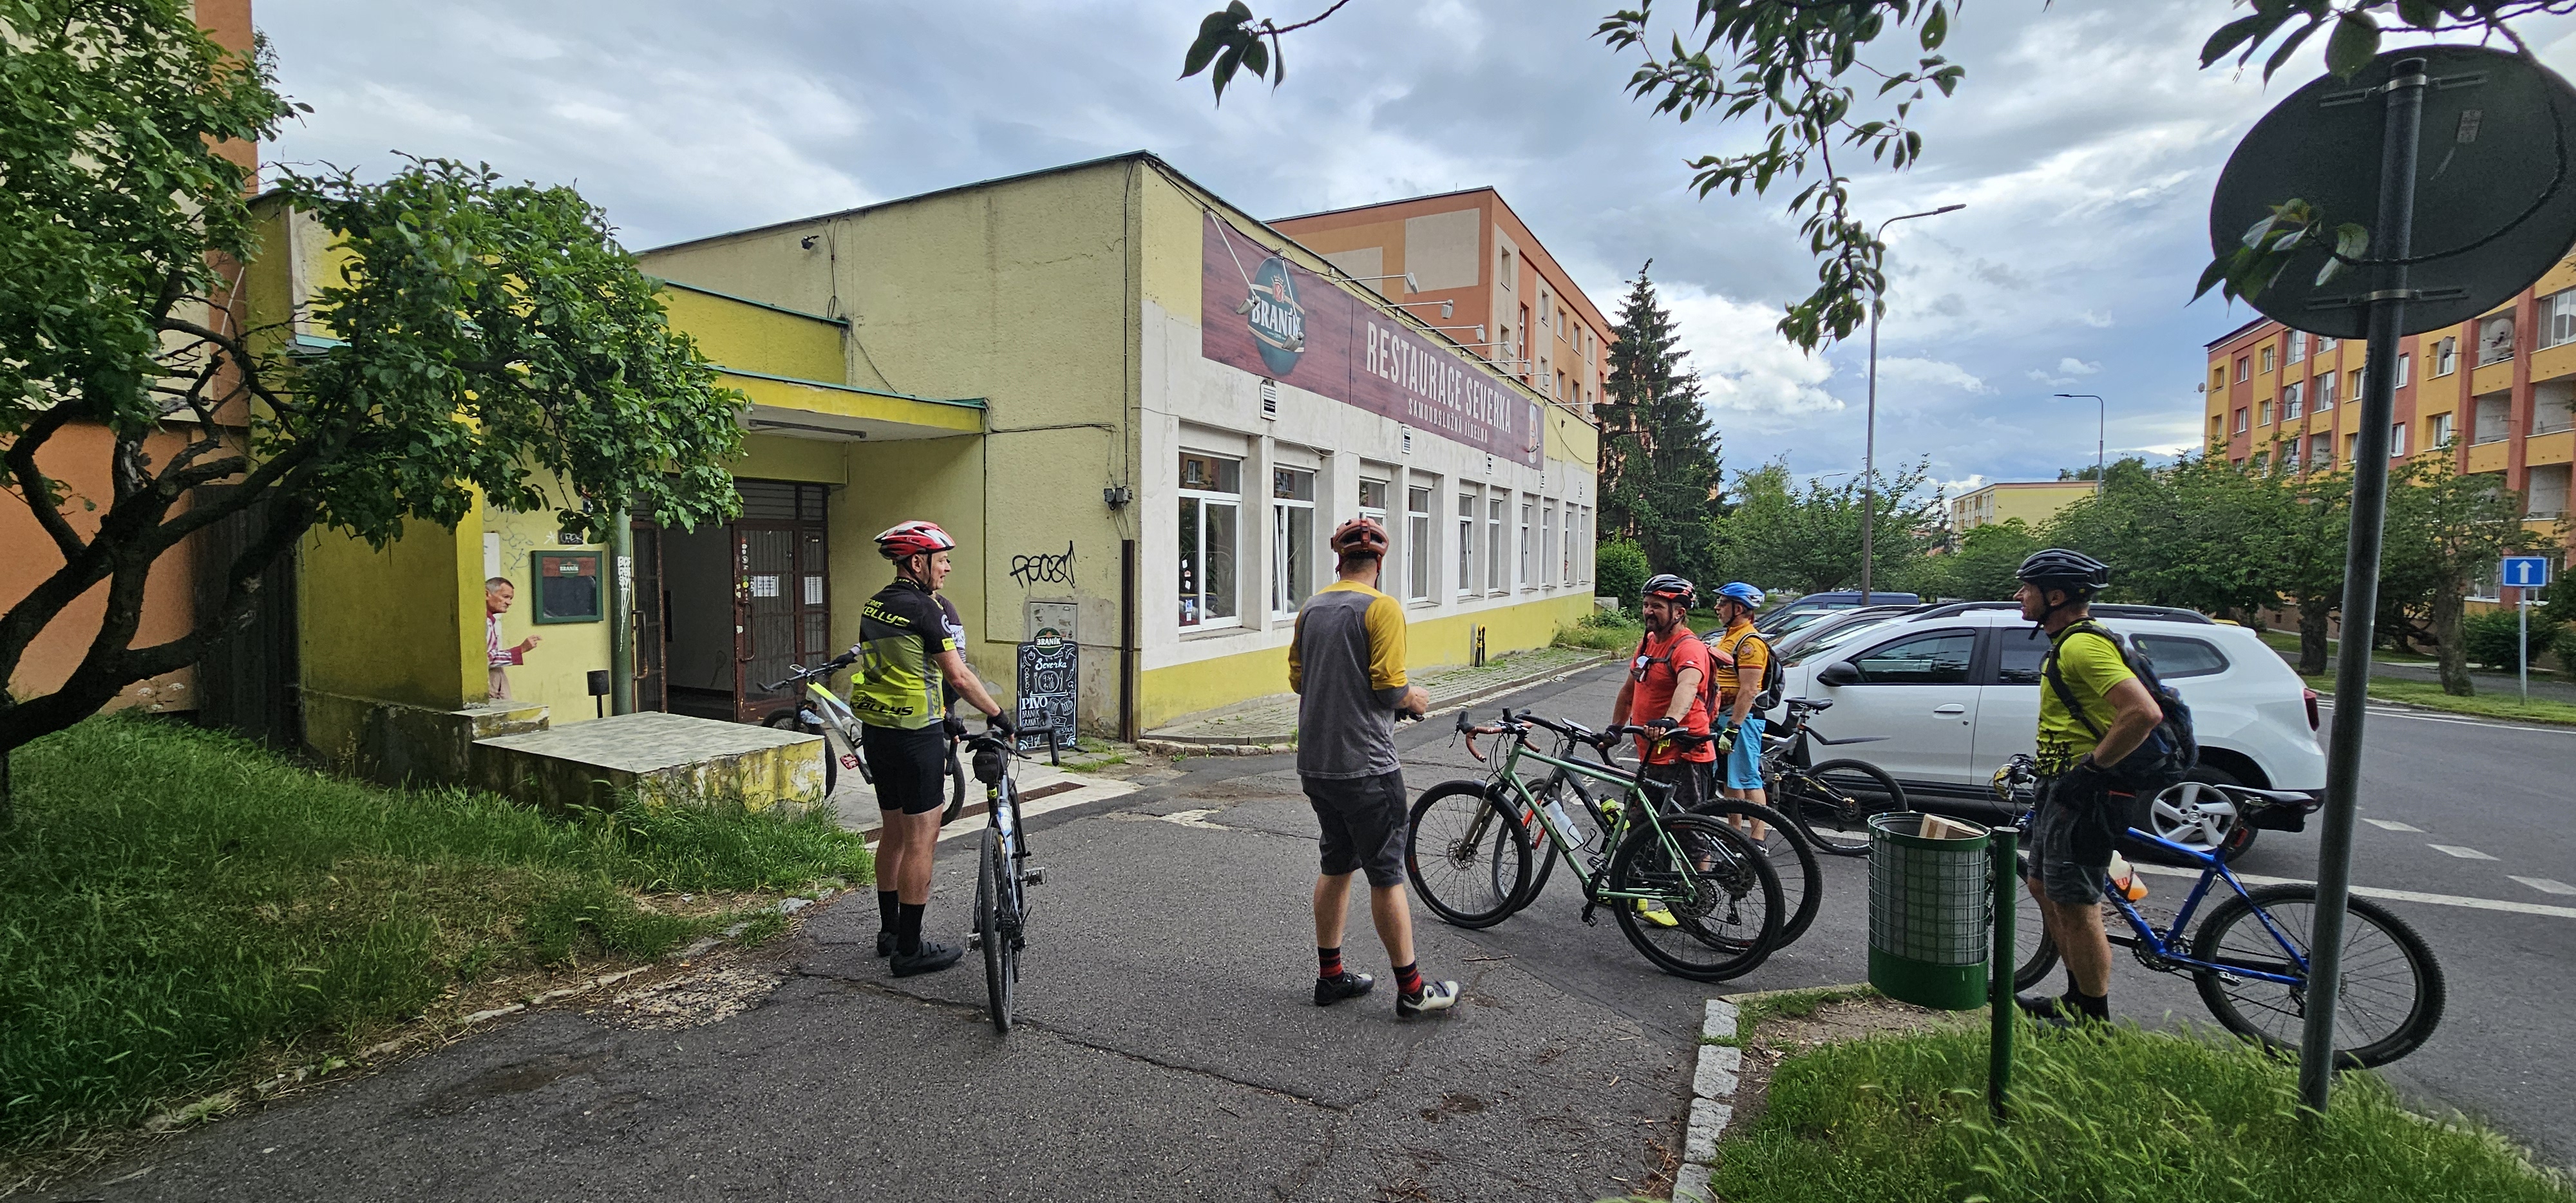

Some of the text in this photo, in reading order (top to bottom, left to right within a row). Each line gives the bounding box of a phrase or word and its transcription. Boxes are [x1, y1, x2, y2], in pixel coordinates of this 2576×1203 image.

[1367, 321, 1511, 434] RESTAURACE SEVERKA
[1408, 397, 1488, 444] SAMOOBSLUŽNÁ JÍDELNA
[1035, 658, 1068, 671] Severka
[1021, 697, 1048, 710] PIVO
